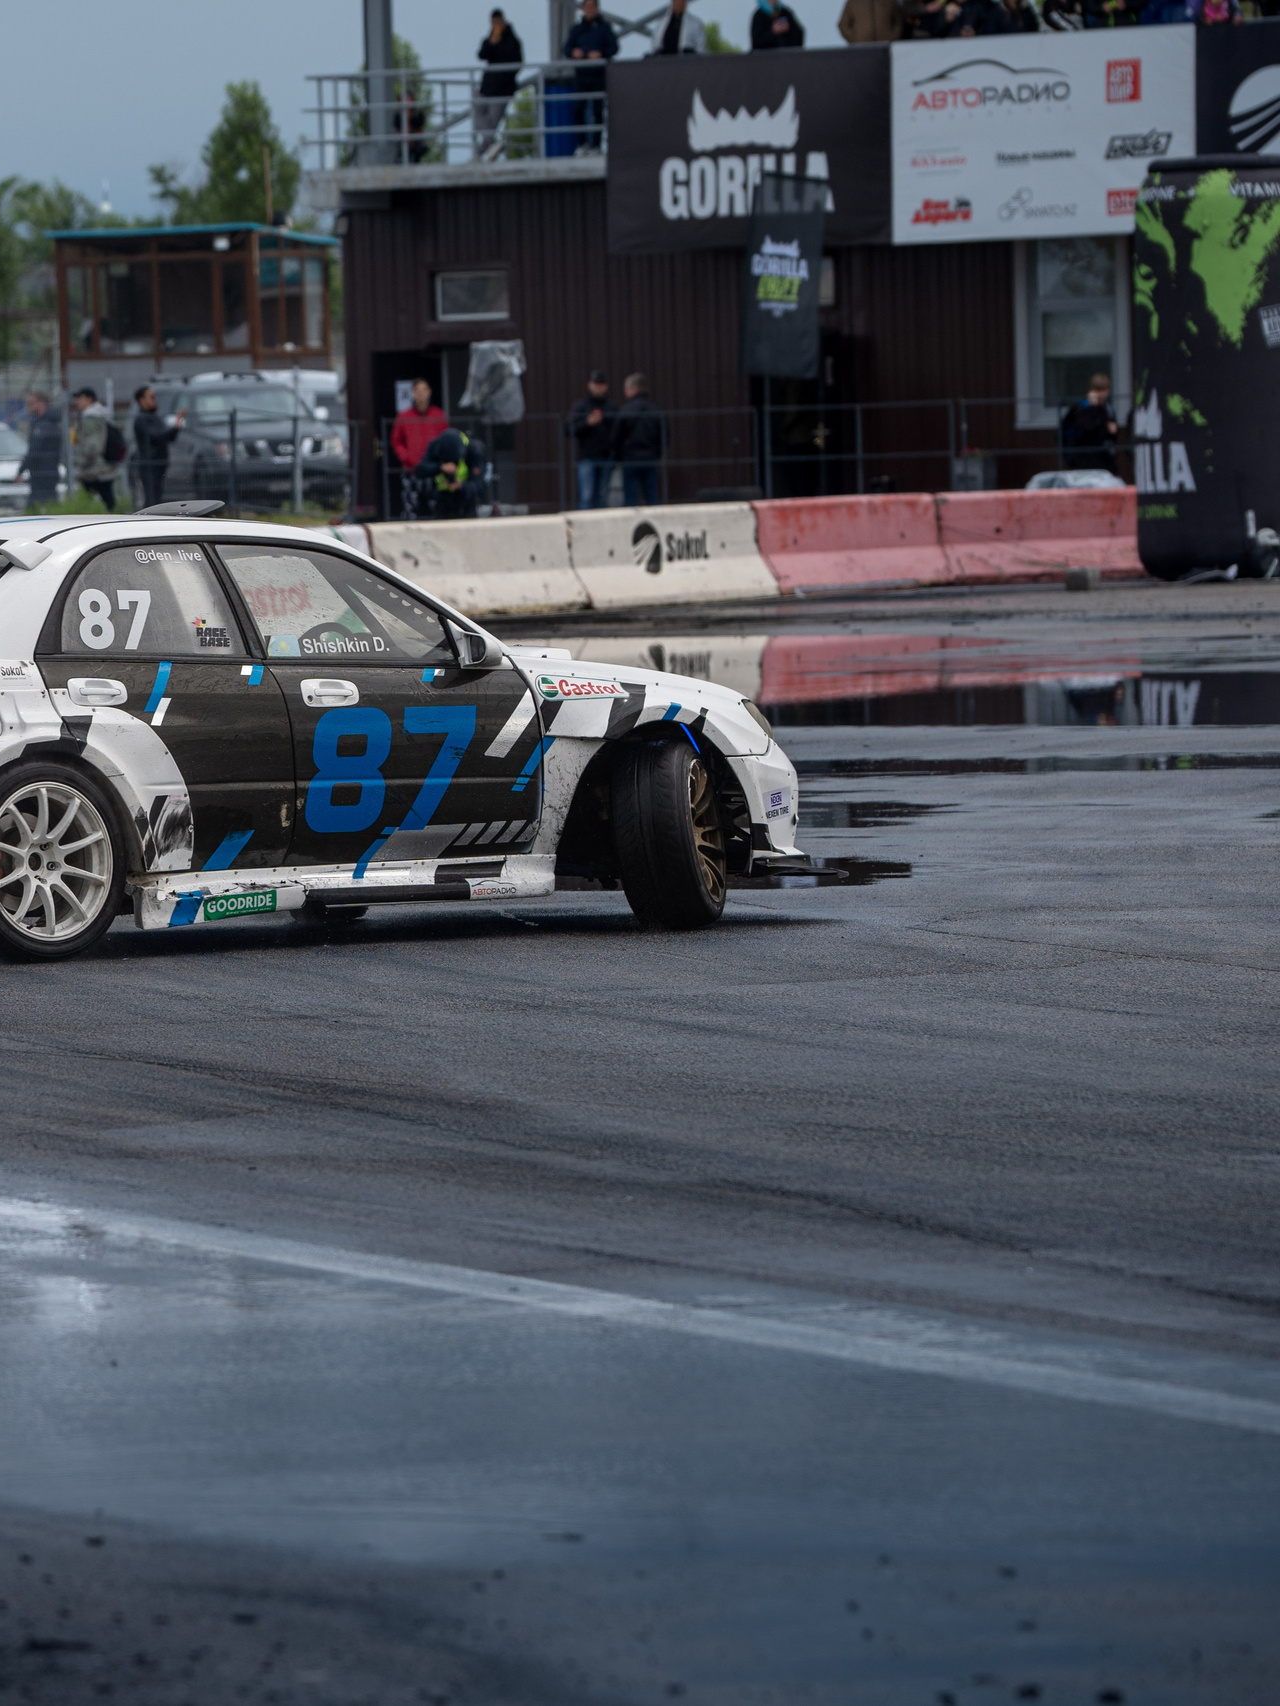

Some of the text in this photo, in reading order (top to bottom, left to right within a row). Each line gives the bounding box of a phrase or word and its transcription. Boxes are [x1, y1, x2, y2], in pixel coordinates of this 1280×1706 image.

[134, 549, 202, 564] @den_live
[78, 588, 151, 650] 87
[195, 627, 228, 638] RACE
[302, 637, 390, 654] Shishkin D.
[558, 679, 624, 697] Castrol
[305, 705, 477, 833] 87
[207, 894, 273, 913] GOODRIDE
